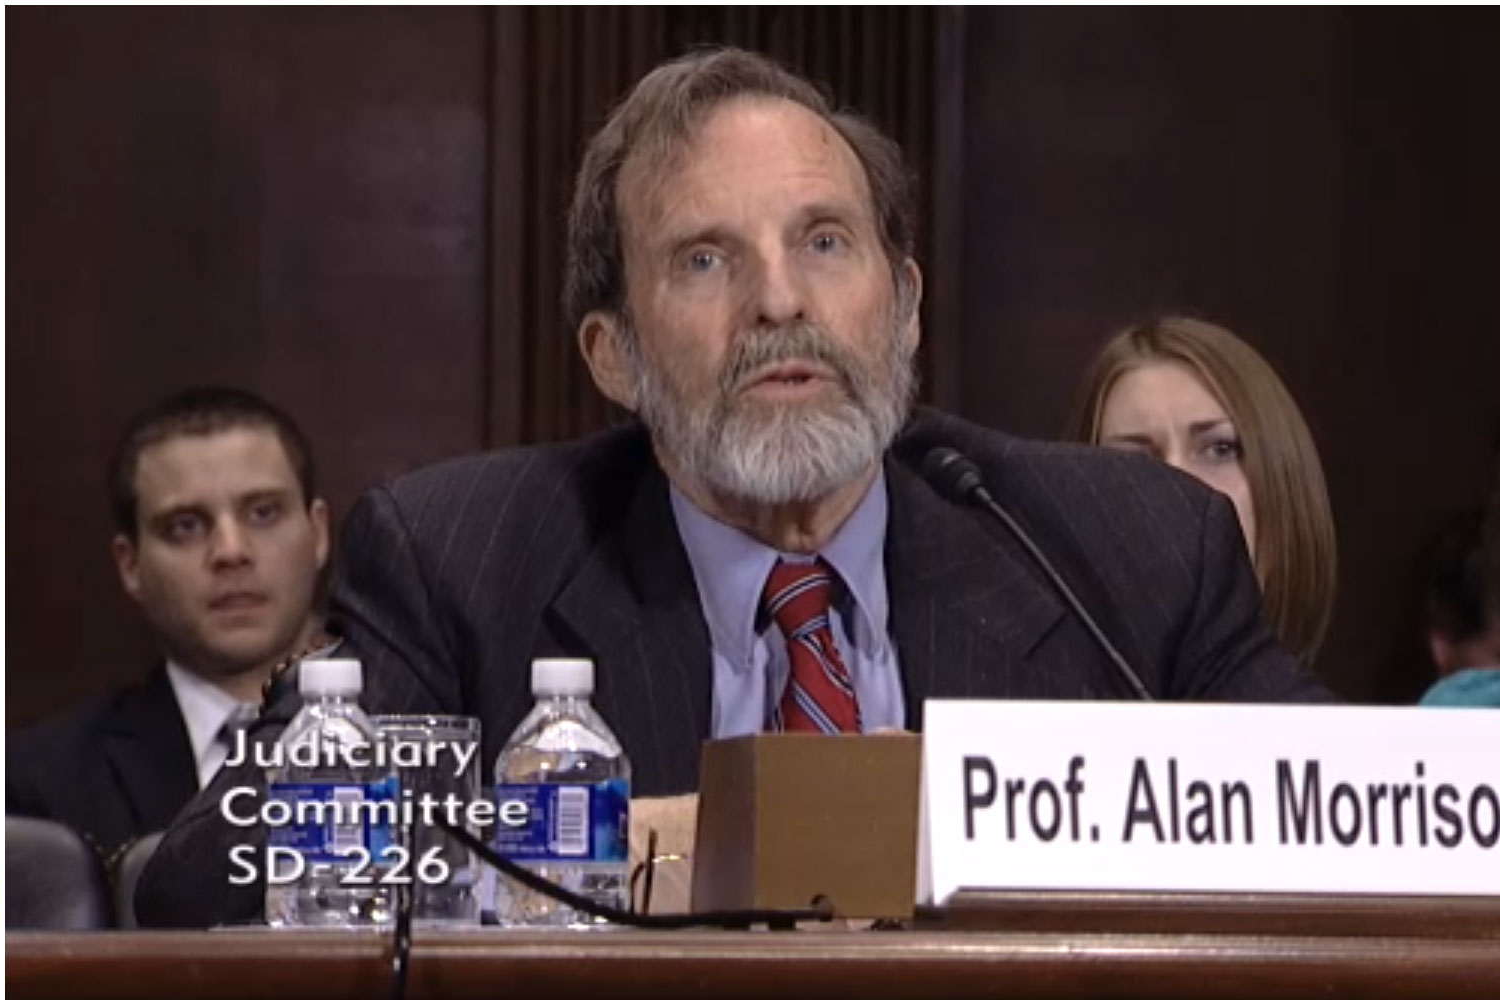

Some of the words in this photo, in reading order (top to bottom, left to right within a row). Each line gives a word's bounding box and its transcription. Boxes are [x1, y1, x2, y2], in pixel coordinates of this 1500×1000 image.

[962, 755, 1101, 842] Prof.
[1122, 757, 1254, 845] Alan
[1275, 759, 1500, 849] Morriso
